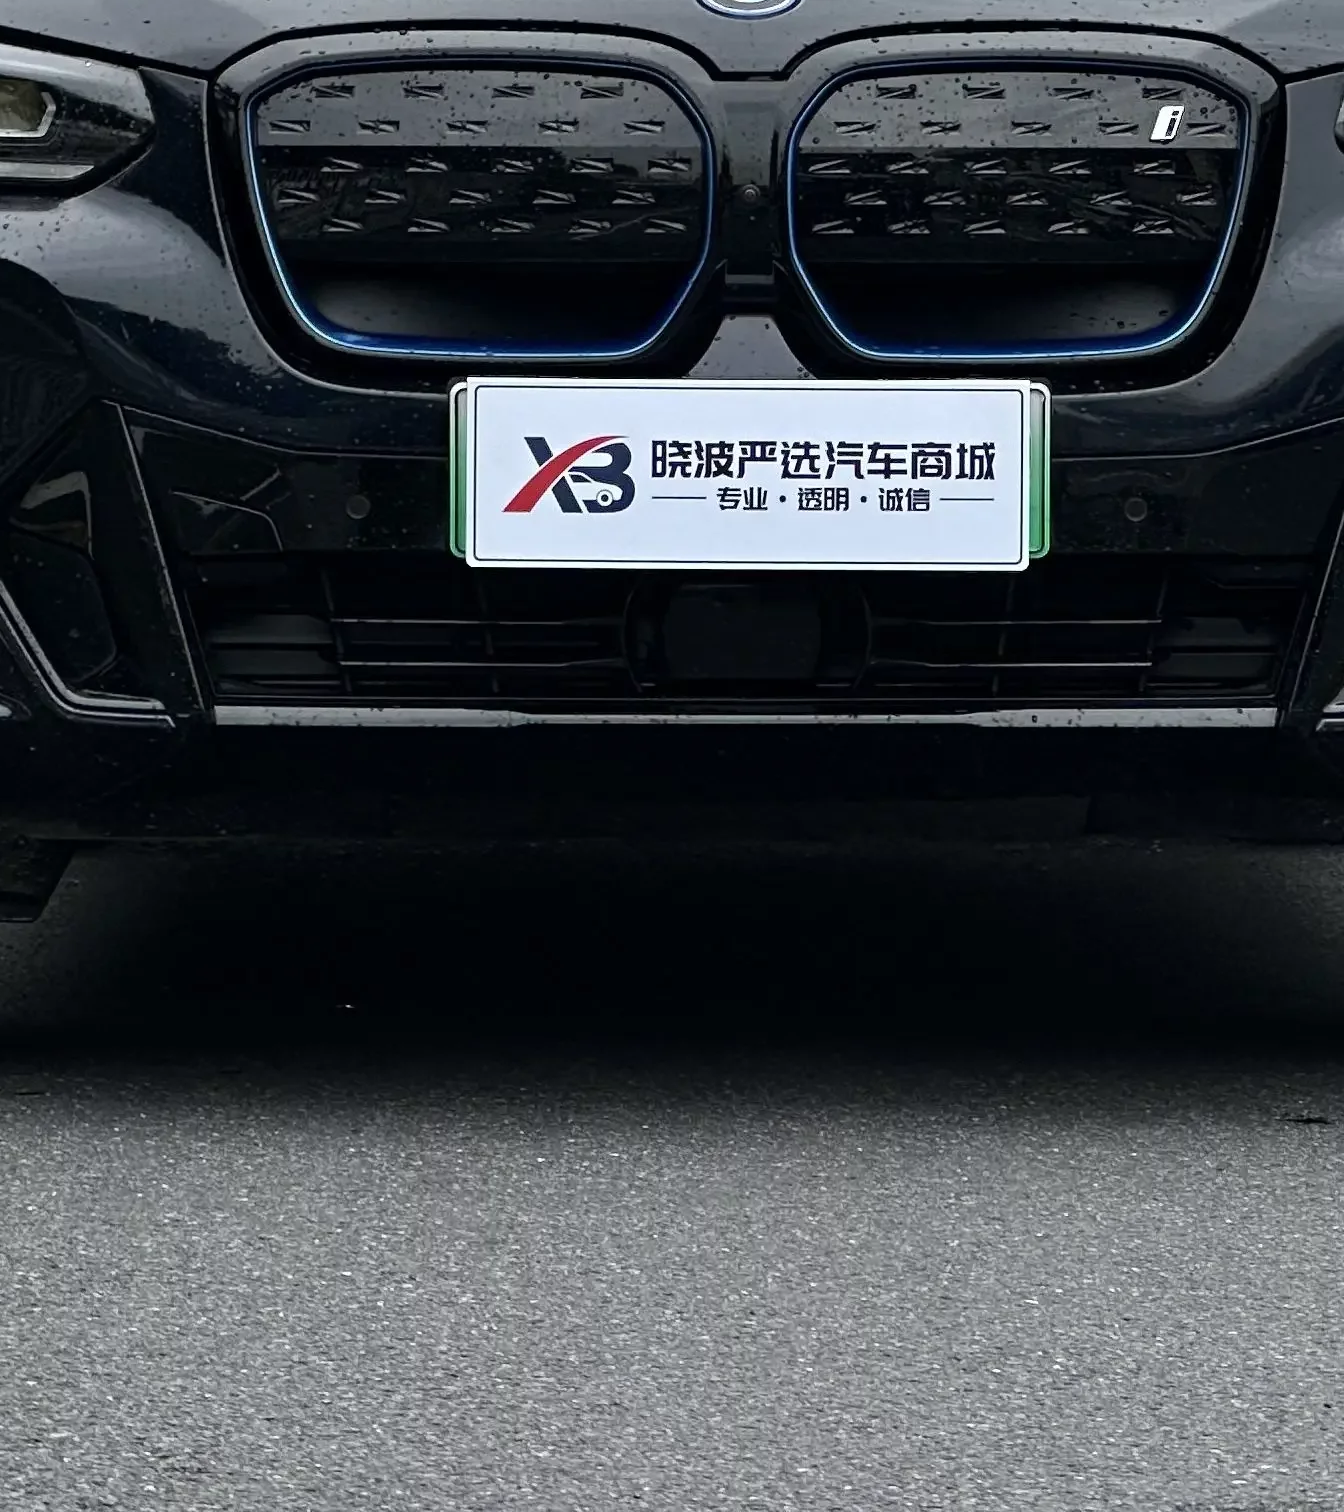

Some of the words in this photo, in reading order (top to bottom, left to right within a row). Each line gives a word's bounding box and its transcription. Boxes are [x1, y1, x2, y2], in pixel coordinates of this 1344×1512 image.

[651, 440, 996, 481] 晓波严选汽车商城
